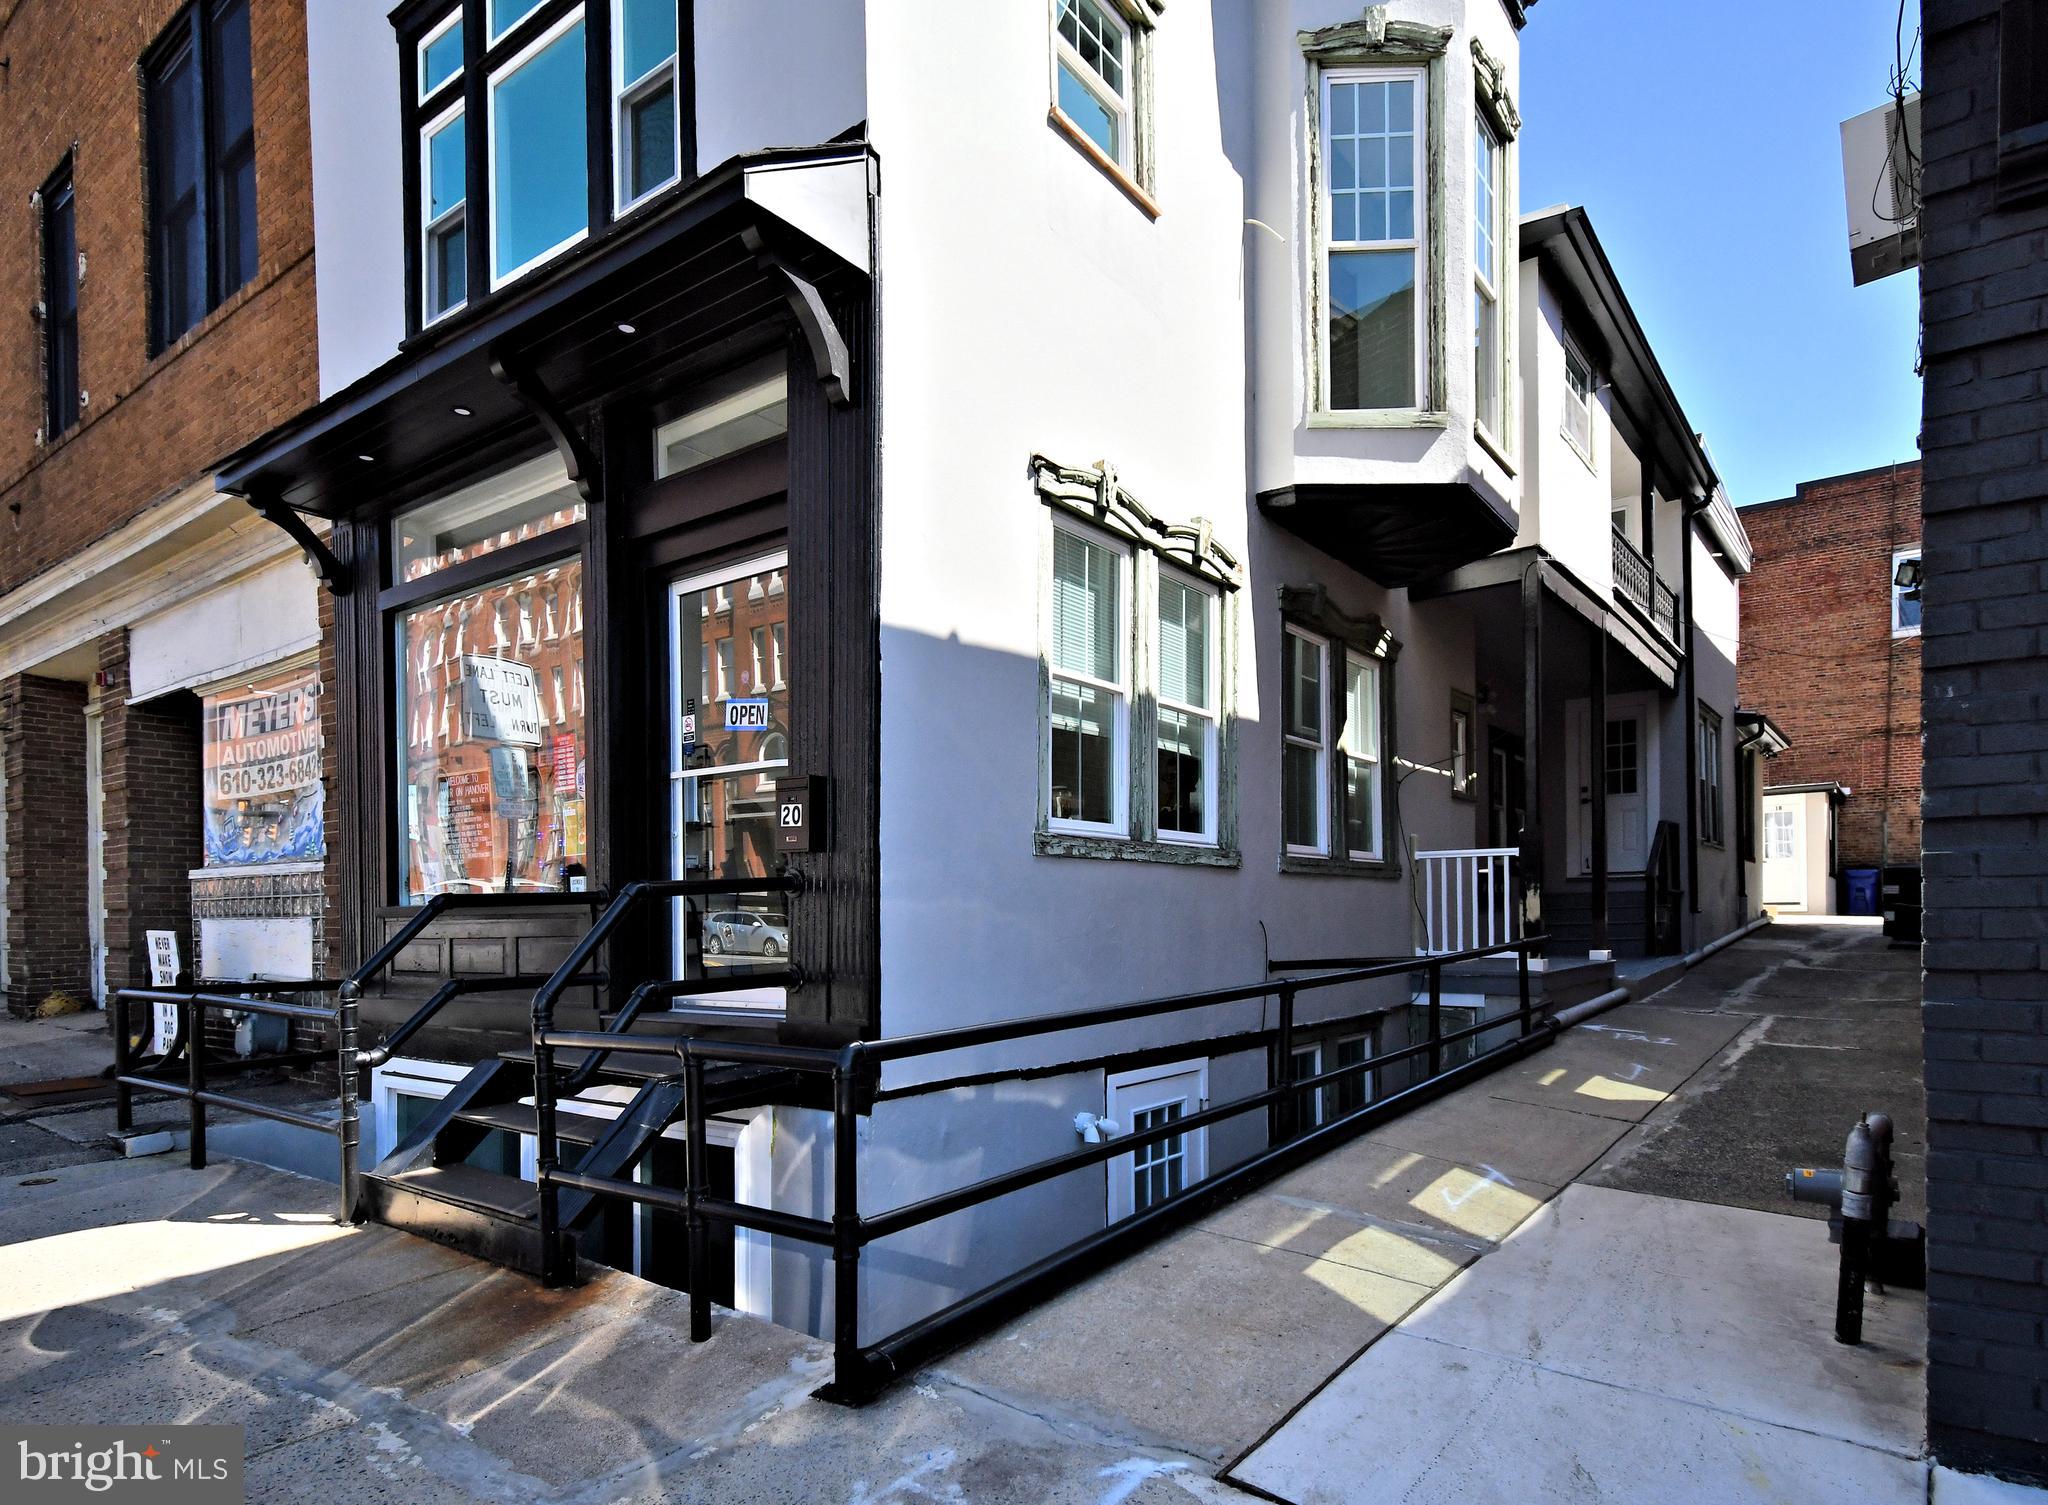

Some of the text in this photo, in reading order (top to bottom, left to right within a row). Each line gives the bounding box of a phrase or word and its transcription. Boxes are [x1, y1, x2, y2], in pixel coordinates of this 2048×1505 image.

[222, 683, 315, 740] MEYERS
[730, 705, 765, 725] OPEN
[222, 726, 316, 765] AUTOMOTIVE
[220, 755, 317, 795] 610-323-6842
[446, 773, 479, 787] WELCOME TO
[464, 783, 489, 796] HANOVER
[783, 805, 801, 825] 20
[155, 937, 171, 950] NEVER
[157, 954, 171, 967] MAKE
[159, 971, 174, 984] SNOW
[162, 1004, 174, 1018] IN A
[164, 1021, 174, 1035] DOG
[162, 1037, 174, 1050] PAR
